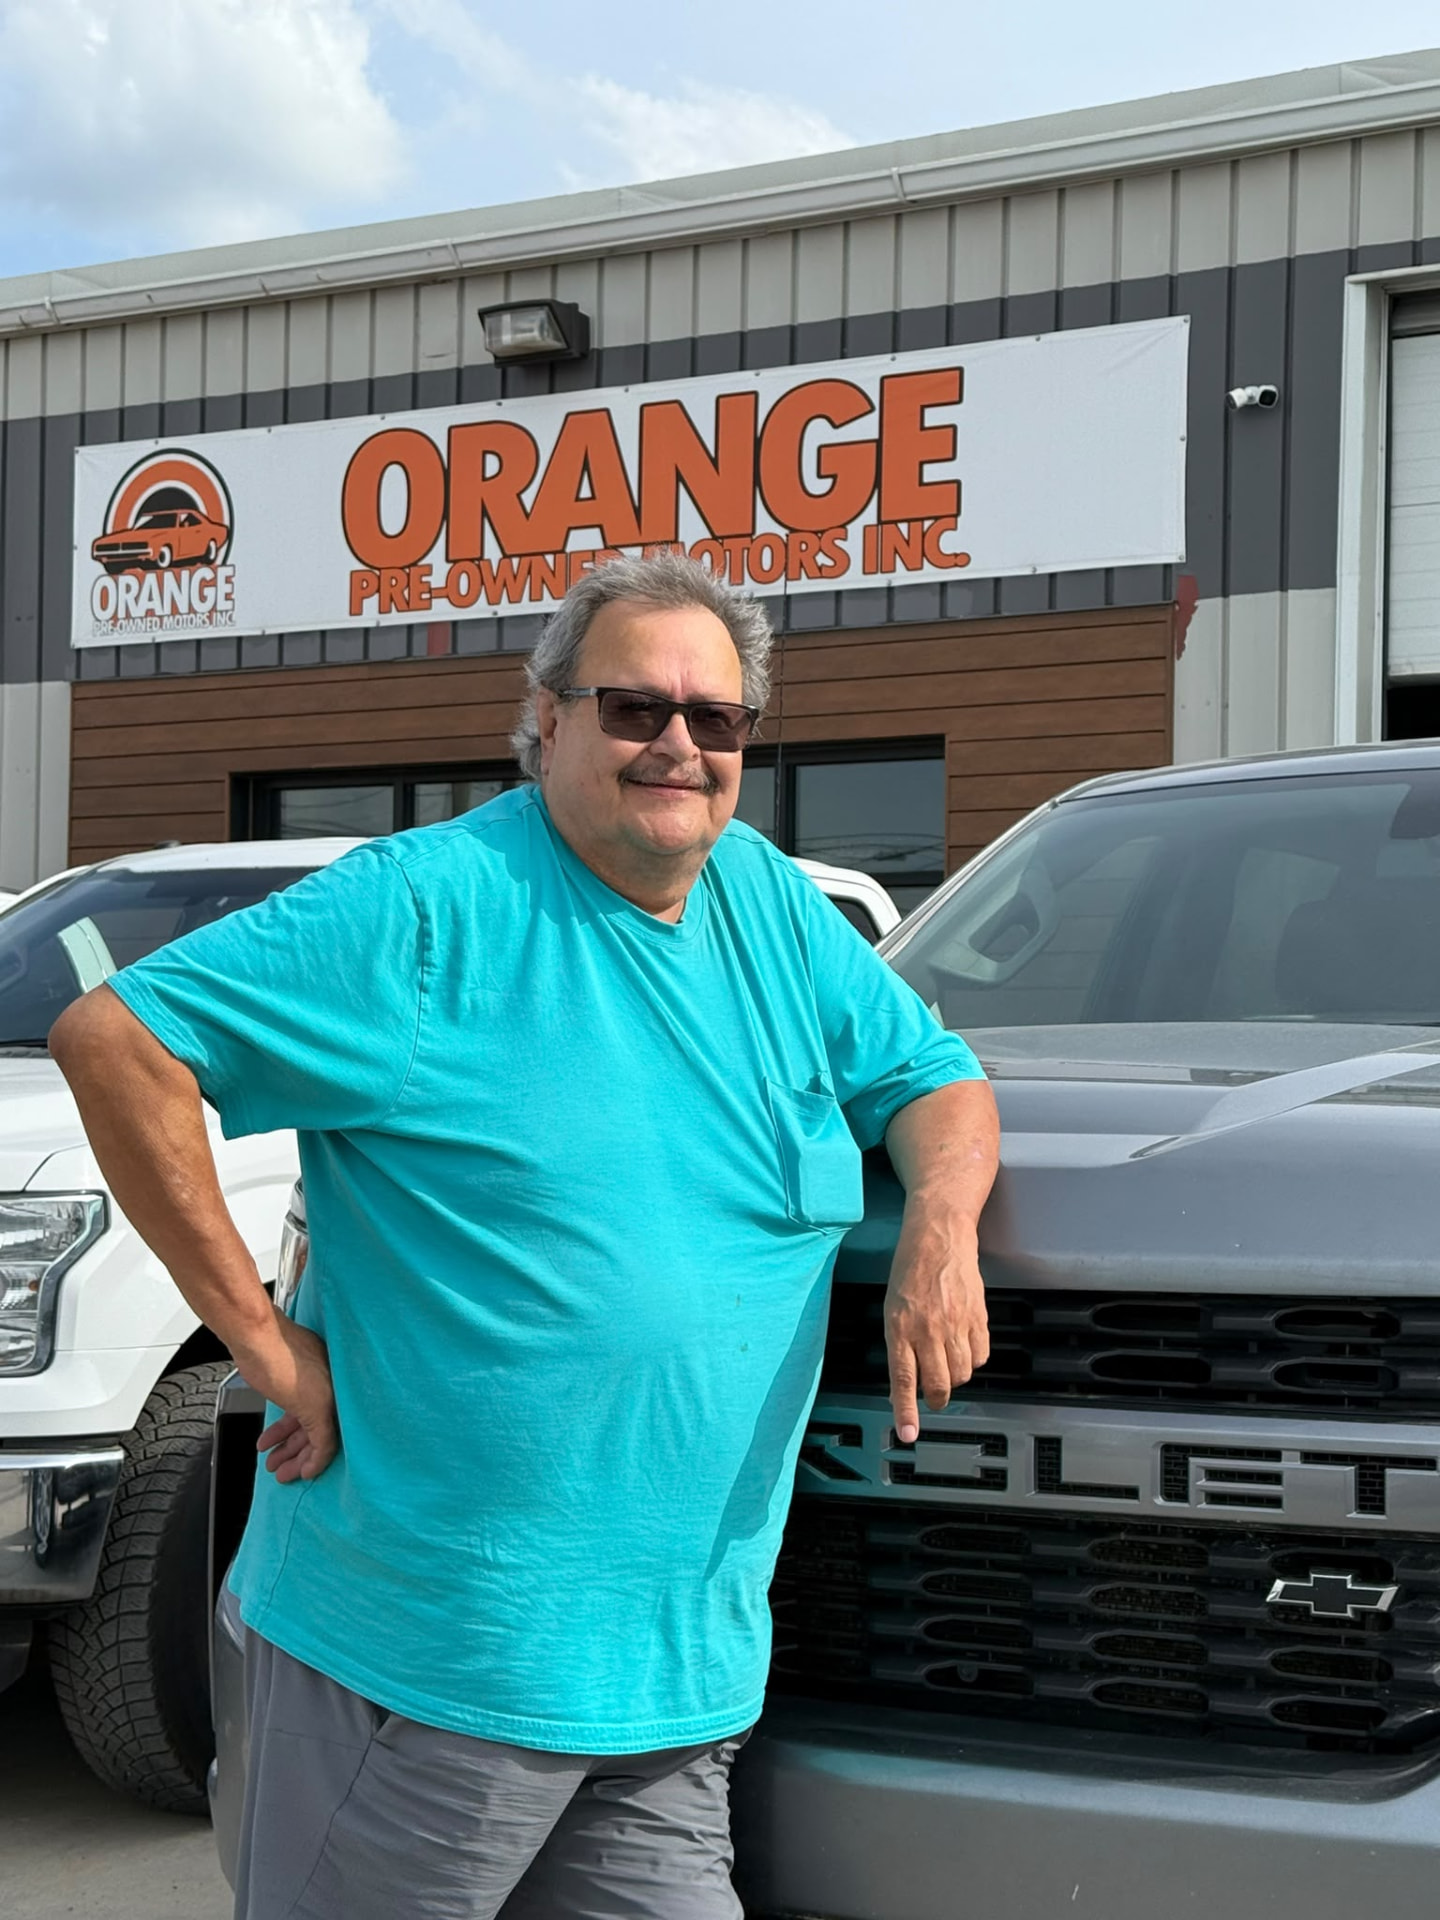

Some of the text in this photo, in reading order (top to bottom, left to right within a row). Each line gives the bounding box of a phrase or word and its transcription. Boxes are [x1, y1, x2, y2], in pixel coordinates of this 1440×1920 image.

[341, 366, 964, 570] ORANGE
[90, 564, 236, 621] ORANGE
[348, 548, 625, 616] PRE-OWNE
[862, 515, 971, 575] INC.
[92, 617, 161, 637] PRE-OWNED
[162, 611, 210, 631] MOTORS
